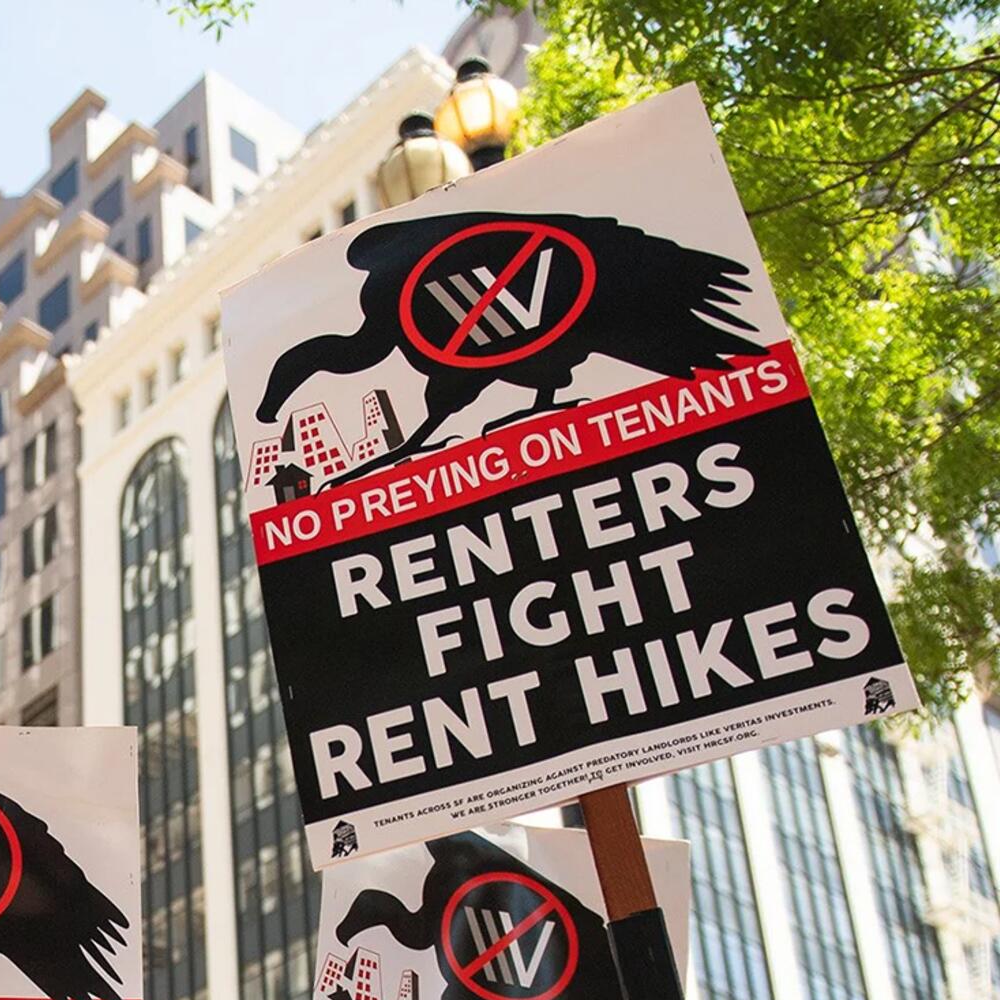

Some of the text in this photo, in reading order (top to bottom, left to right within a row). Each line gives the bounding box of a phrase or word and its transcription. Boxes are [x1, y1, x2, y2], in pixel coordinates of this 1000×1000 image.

[265, 358, 790, 551] NO PREYING ON TENANTS
[331, 442, 756, 618] RENTERS
[416, 541, 694, 678] FIGHT
[309, 587, 871, 800] RENT HIKES
[374, 811, 415, 828] TENANTS
[416, 801, 451, 817] ACROSS
[453, 797, 464, 808] SF
[467, 792, 485, 804] ARE
[486, 776, 544, 799] ORGANIZING
[545, 763, 584, 782] AGAINST
[586, 749, 641, 769] PREDATORY
[642, 733, 698, 755] LANDLORDS
[699, 727, 722, 739] LIKE
[722, 716, 763, 732] VERITAS
[450, 809, 466, 820] WE
[468, 804, 486, 816] ARE
[487, 790, 537, 811] STRONGER
[605, 763, 624, 775] GET
[677, 744, 702, 758] VISIT
